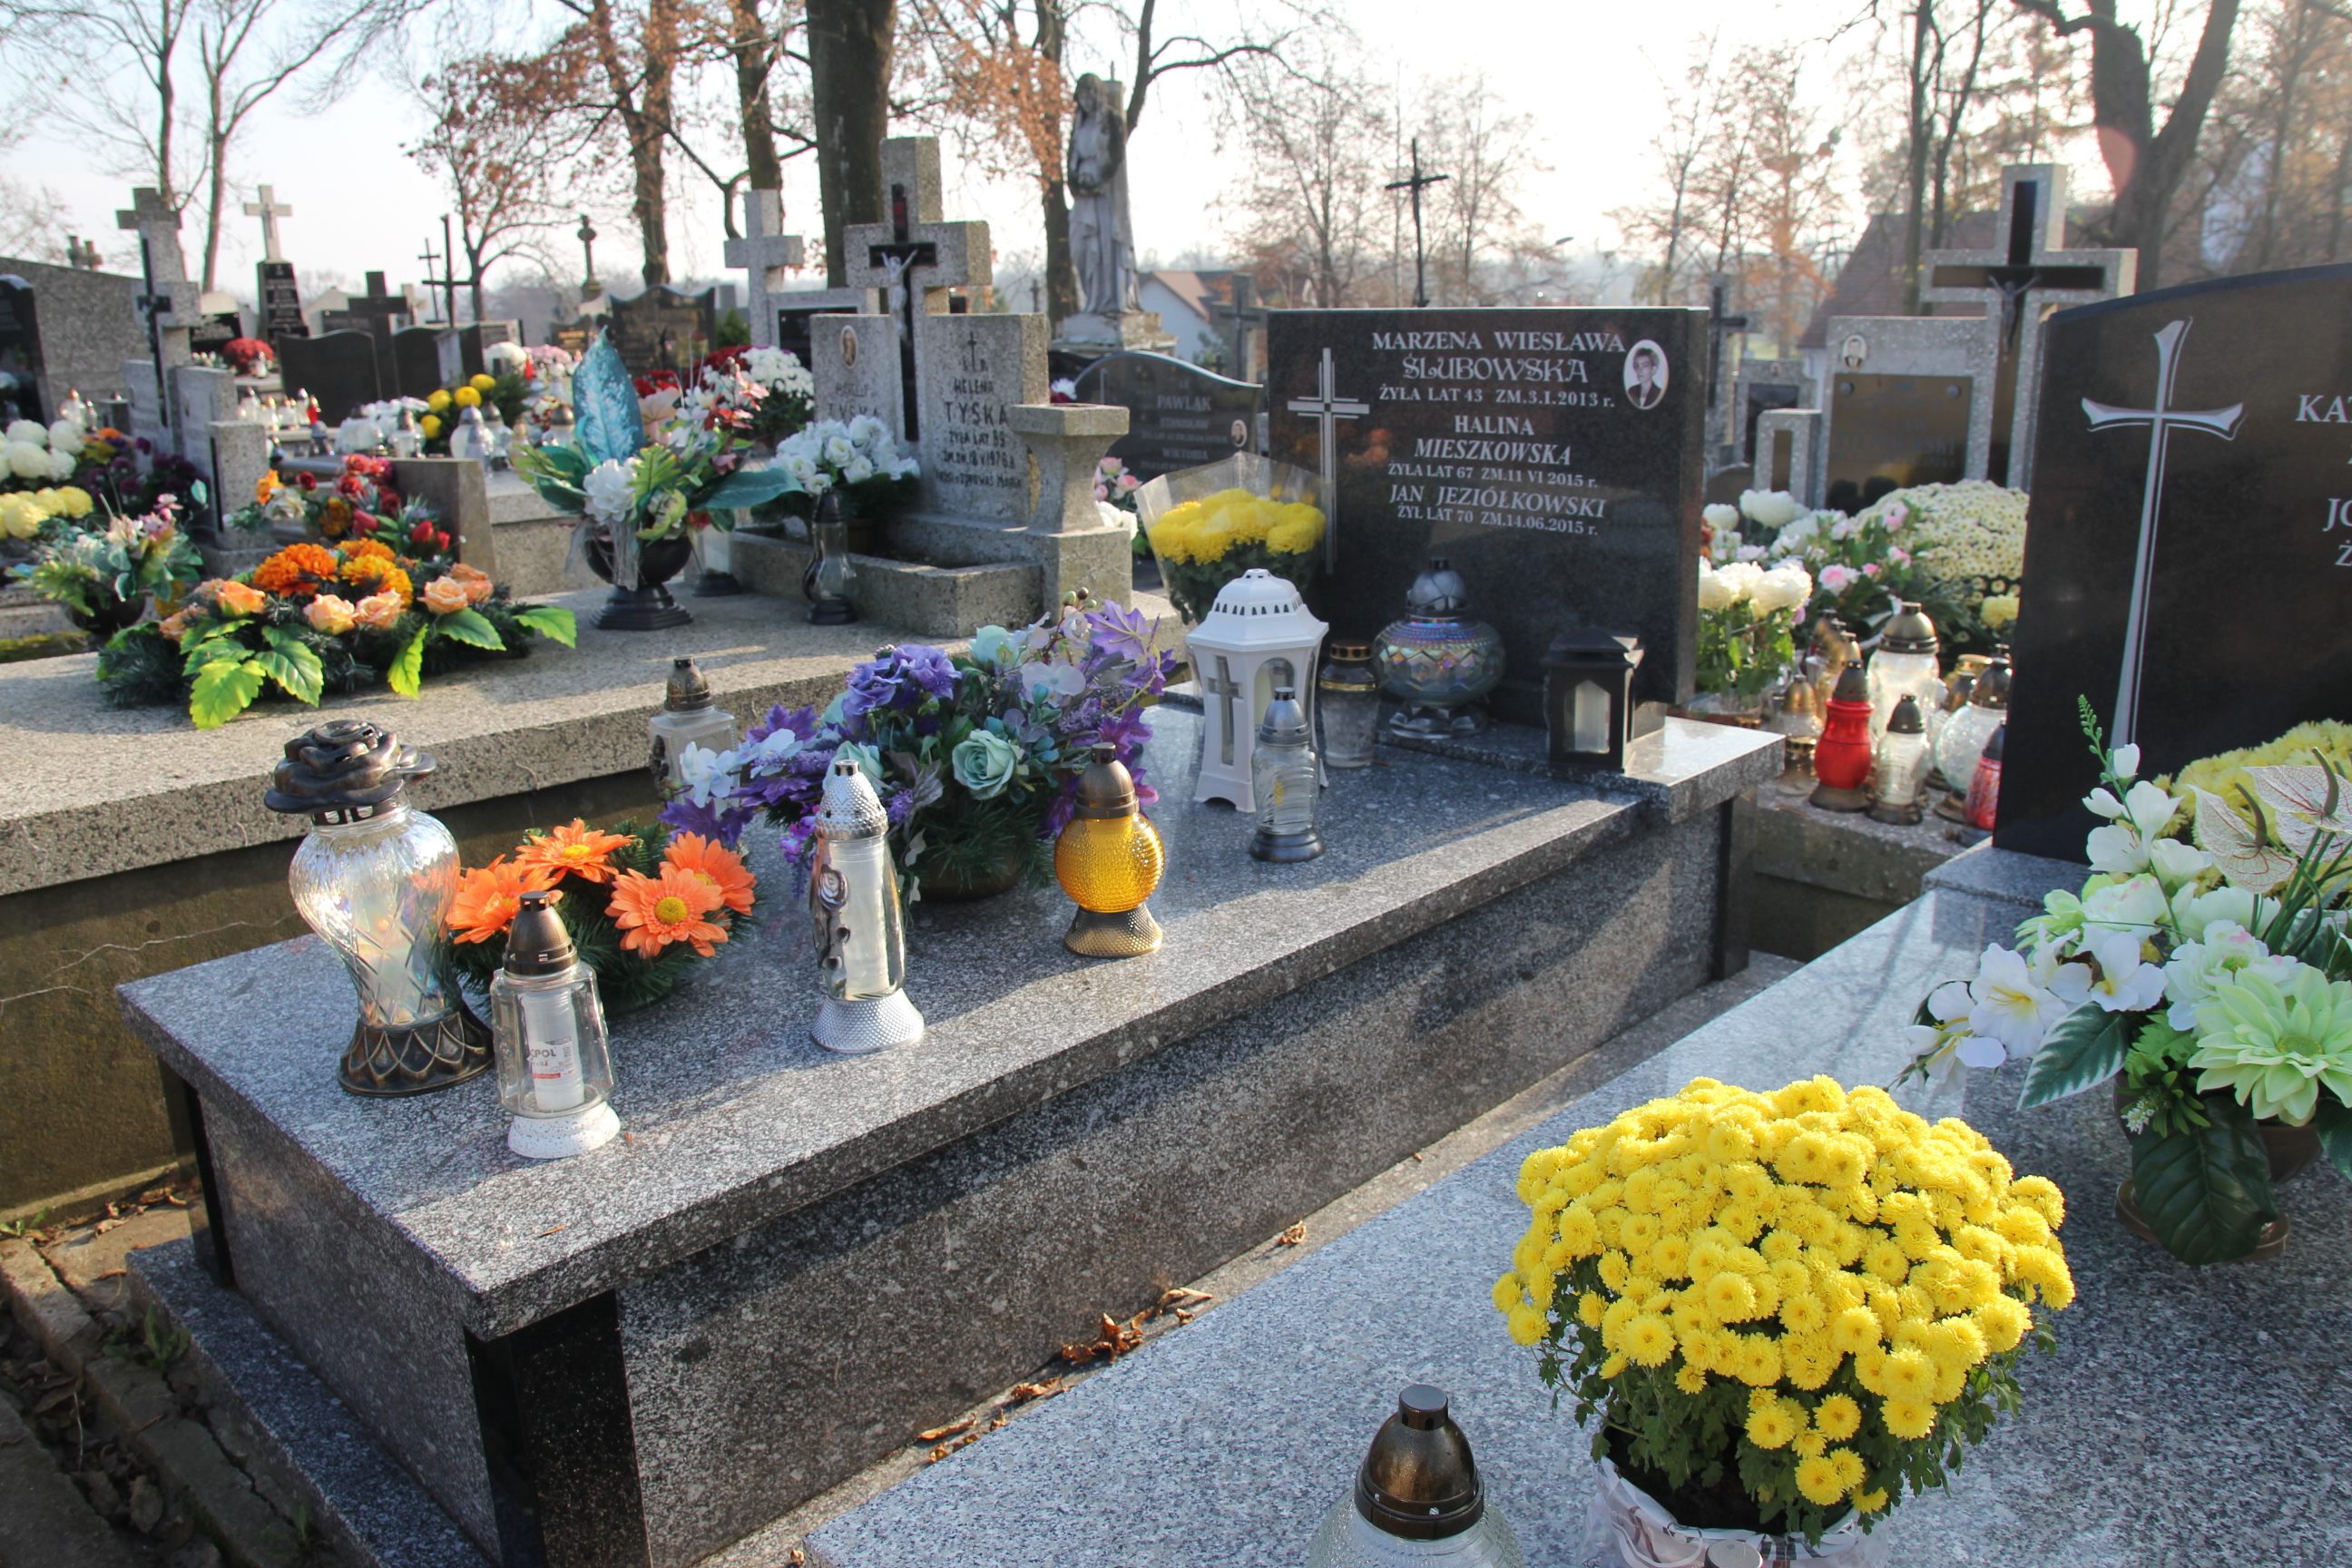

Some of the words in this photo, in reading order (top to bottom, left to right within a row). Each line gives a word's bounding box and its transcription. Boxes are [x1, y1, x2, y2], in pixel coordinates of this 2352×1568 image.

[1372, 332, 1483, 350] MARZENA
[1494, 332, 1626, 352] WIESŁAWA
[1403, 353, 1588, 383] ŚLUBOWSKA
[1157, 395, 1211, 411] PAWLAK
[1379, 384, 1421, 401] ŻYŁA
[1428, 387, 1461, 401] LAT
[1464, 389, 1484, 402] 43
[945, 401, 1008, 426] TYSKA
[2295, 395, 2352, 423] KA
[1455, 415, 1534, 436] HALINA
[1414, 438, 1572, 466] MIESZKOWSKA
[1387, 460, 1423, 476] ŻYŁA
[1426, 465, 1454, 478] LAT
[1456, 466, 1474, 479] 67
[1527, 470, 1544, 484] VI
[1547, 472, 1584, 487] 2015
[1389, 485, 1425, 504] JAN
[1436, 485, 1606, 517] JEZIÓŁKOWSKI
[1397, 503, 1424, 520] ŻYŁ
[1426, 507, 1454, 522] LAT
[1456, 510, 1474, 523] 70
